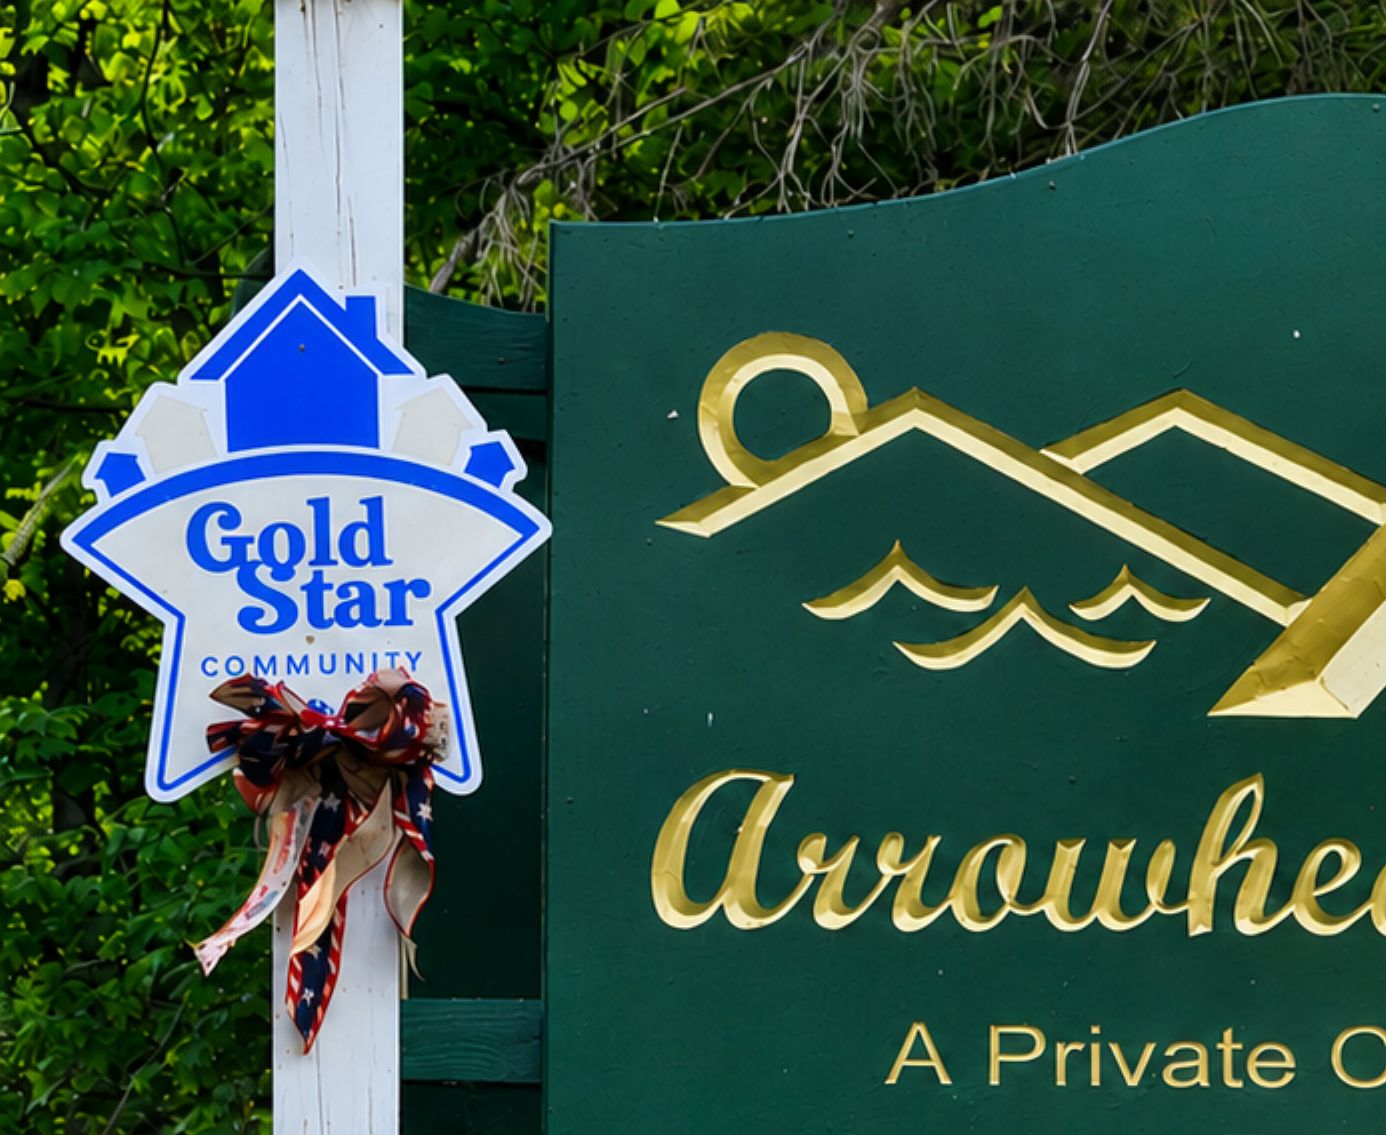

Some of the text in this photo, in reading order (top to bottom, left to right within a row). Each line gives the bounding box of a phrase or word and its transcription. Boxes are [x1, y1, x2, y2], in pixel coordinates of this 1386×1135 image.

[186, 495, 394, 572] Gold
[237, 560, 431, 635] Star
[200, 649, 423, 679] COMMUNITY
[885, 1023, 952, 1086] A
[989, 1025, 1296, 1089] Private
